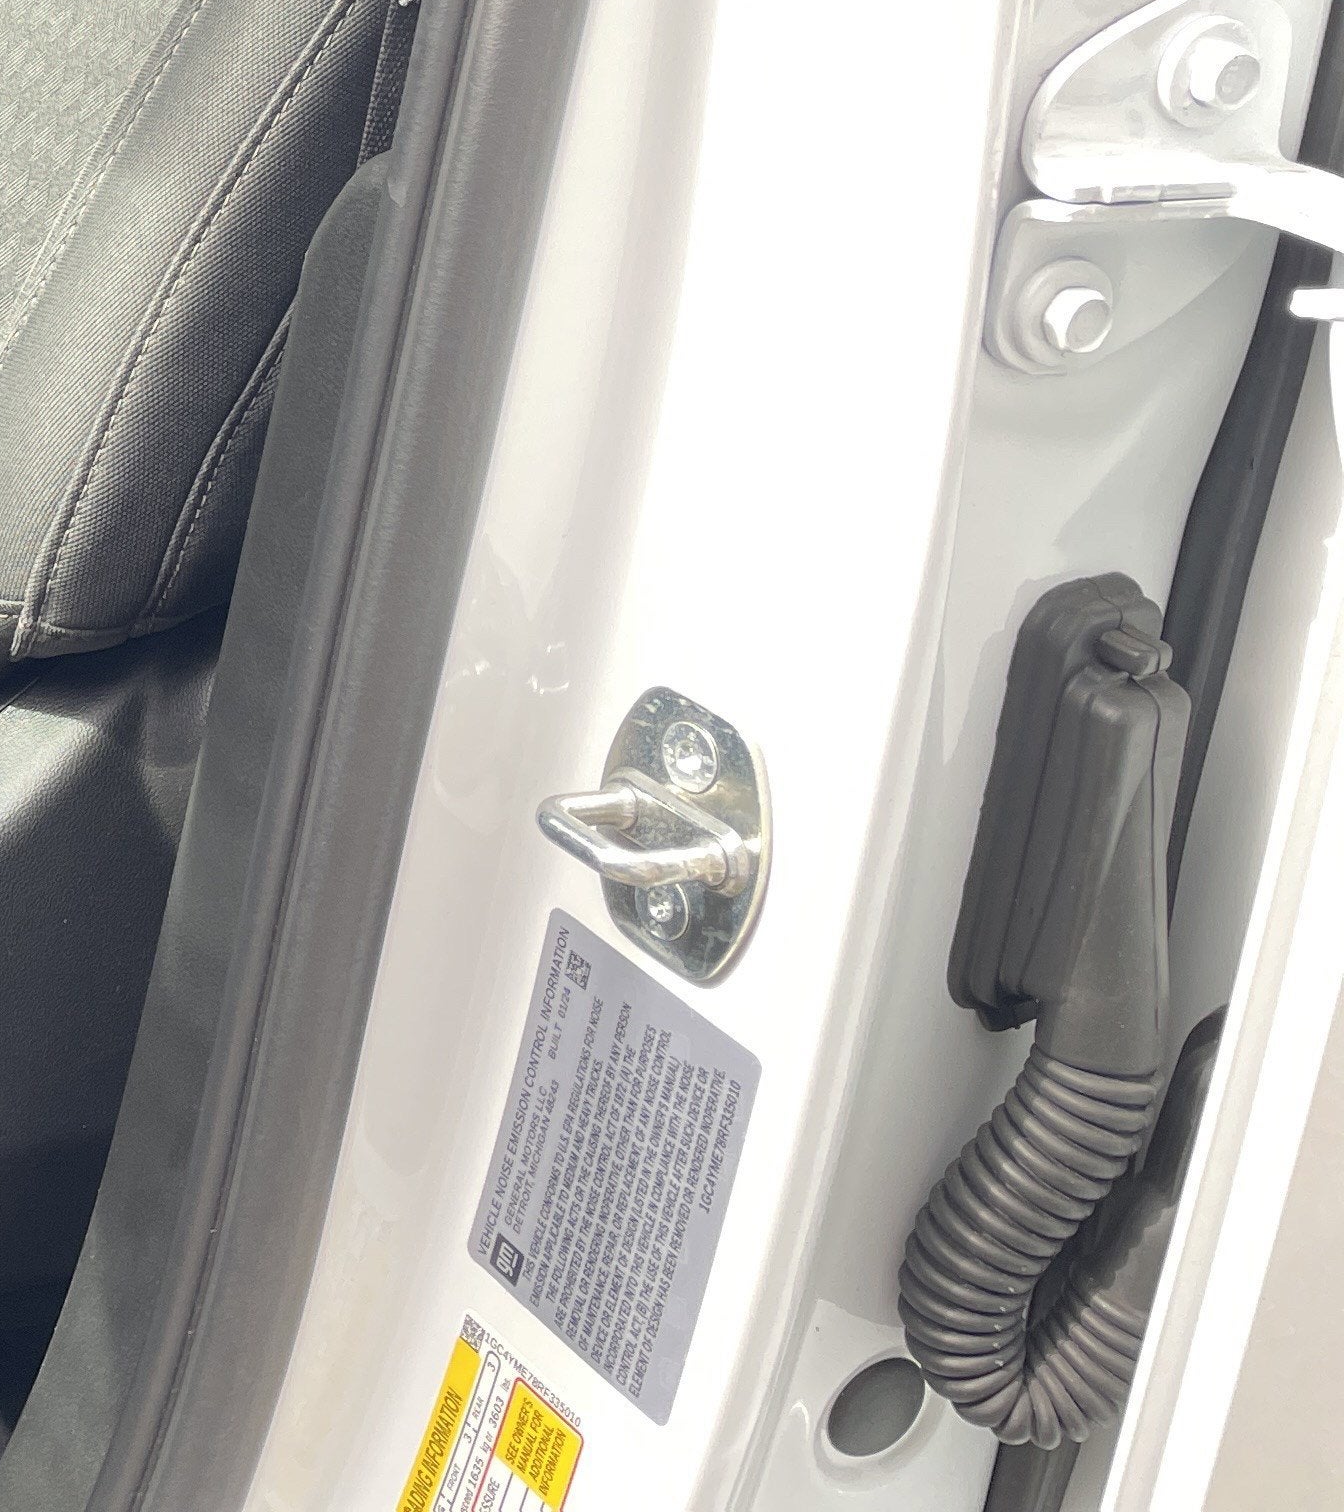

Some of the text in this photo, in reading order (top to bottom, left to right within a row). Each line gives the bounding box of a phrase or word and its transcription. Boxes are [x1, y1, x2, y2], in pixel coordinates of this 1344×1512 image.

[588, 995, 604, 1028] NOISE
[583, 1026, 596, 1049] FOR
[622, 1044, 636, 1065] THE
[634, 1023, 657, 1079] PURPOSES
[650, 1029, 672, 1076] CONTROL
[477, 926, 569, 1255] VEHICLE NOISE EMISSION CONTROL INFORMATION
[567, 1047, 591, 1114] REGULATIONS
[618, 1065, 633, 1084] (A)
[629, 1076, 643, 1100] FOR
[643, 1074, 660, 1106] NOISE
[696, 1066, 709, 1085] OR
[503, 986, 571, 1226] GENERAL MOTORS LLC BUILT 01/24
[577, 1098, 592, 1132] HEAVY
[609, 1103, 620, 1122] OF
[622, 1097, 638, 1125] THAN
[638, 1104, 651, 1128] ANY
[687, 1082, 706, 1122] DEVICE
[527, 1114, 550, 1178] MICHIGAN
[544, 1079, 559, 1115] 48243
[562, 1113, 575, 1135] EPA
[572, 1129, 585, 1153] AND
[604, 1119, 617, 1143] ACT
[634, 1125, 646, 1143] OF
[679, 1119, 696, 1150] SUCH
[544, 1001, 632, 1304] THE FOLLOWING ACTS OR THE CAUSING THEREOF BY ANY PERSON
[553, 1151, 565, 1167] TO
[614, 1125, 631, 1161] OTHER
[698, 1079, 741, 1213] 1GC4YME78RF335010
[562, 1150, 579, 1190] MEDIUM
[592, 1142, 613, 1188] CONTROL
[671, 1147, 688, 1183] AFTER
[686, 1133, 708, 1188] RENDERED
[539, 1165, 561, 1220] CONFORMS
[557, 1188, 570, 1205] TO
[584, 1185, 601, 1218] NOISE
[590, 1055, 682, 1364] DEVICE OR ELEMENT OF DESIGN (LISTED IN THE OWNER'S MANUAL)
[661, 1179, 680, 1223] VEHICLE
[682, 1186, 695, 1205] OR
[542, 1202, 566, 1263] APPLICABLE
[578, 1215, 593, 1237] THE
[603, 1060, 695, 1374] INCORPORATED INTO THIS VEHICLE IN COMPLIANCE WITH THE NOISE
[611, 1211, 623, 1230] OR
[654, 1220, 669, 1246] THIS
[669, 1202, 691, 1252] REMOVED
[528, 1217, 547, 1260] VEHICLE
[574, 1235, 586, 1253] BY
[583, 1223, 606, 1279] RENDERING
[650, 1243, 662, 1262] OF
[495, 1239, 518, 1279] gm
[521, 1257, 536, 1282] THIS
[645, 1258, 660, 1283] USE
[661, 1250, 678, 1281] BEEN
[529, 1260, 549, 1308] EMISSION
[559, 1250, 583, 1309] PROHIBITED
[578, 1277, 591, 1296] OR
[639, 1279, 654, 1302] THE
[656, 1277, 670, 1301] HAS
[553, 1305, 567, 1330] ARE
[565, 1295, 586, 1341] REMOVAL
[635, 1299, 649, 1319] (B)
[645, 1298, 664, 1338] DESIGN
[577, 1333, 589, 1352] OF
[641, 1333, 653, 1353] OF
[615, 1339, 637, 1386] CONTROL
[628, 1349, 649, 1398] ELEMENT
[471, 1360, 496, 1420] REAR 3
[488, 1395, 505, 1429] 3603
[479, 1440, 493, 1455] kg
[484, 1430, 493, 1443] or
[504, 1397, 533, 1465] SEE OWNER'S
[516, 1409, 543, 1474] MANUAL FOR
[403, 1386, 462, 1512] ADING INFORMATION
[446, 1432, 472, 1491] FRONT 3
[528, 1424, 554, 1482] ADDITIONAL
[538, 1428, 566, 1496] INFORMATION
[467, 1456, 484, 1489] 1635
[478, 1475, 500, 1512] SSURE
